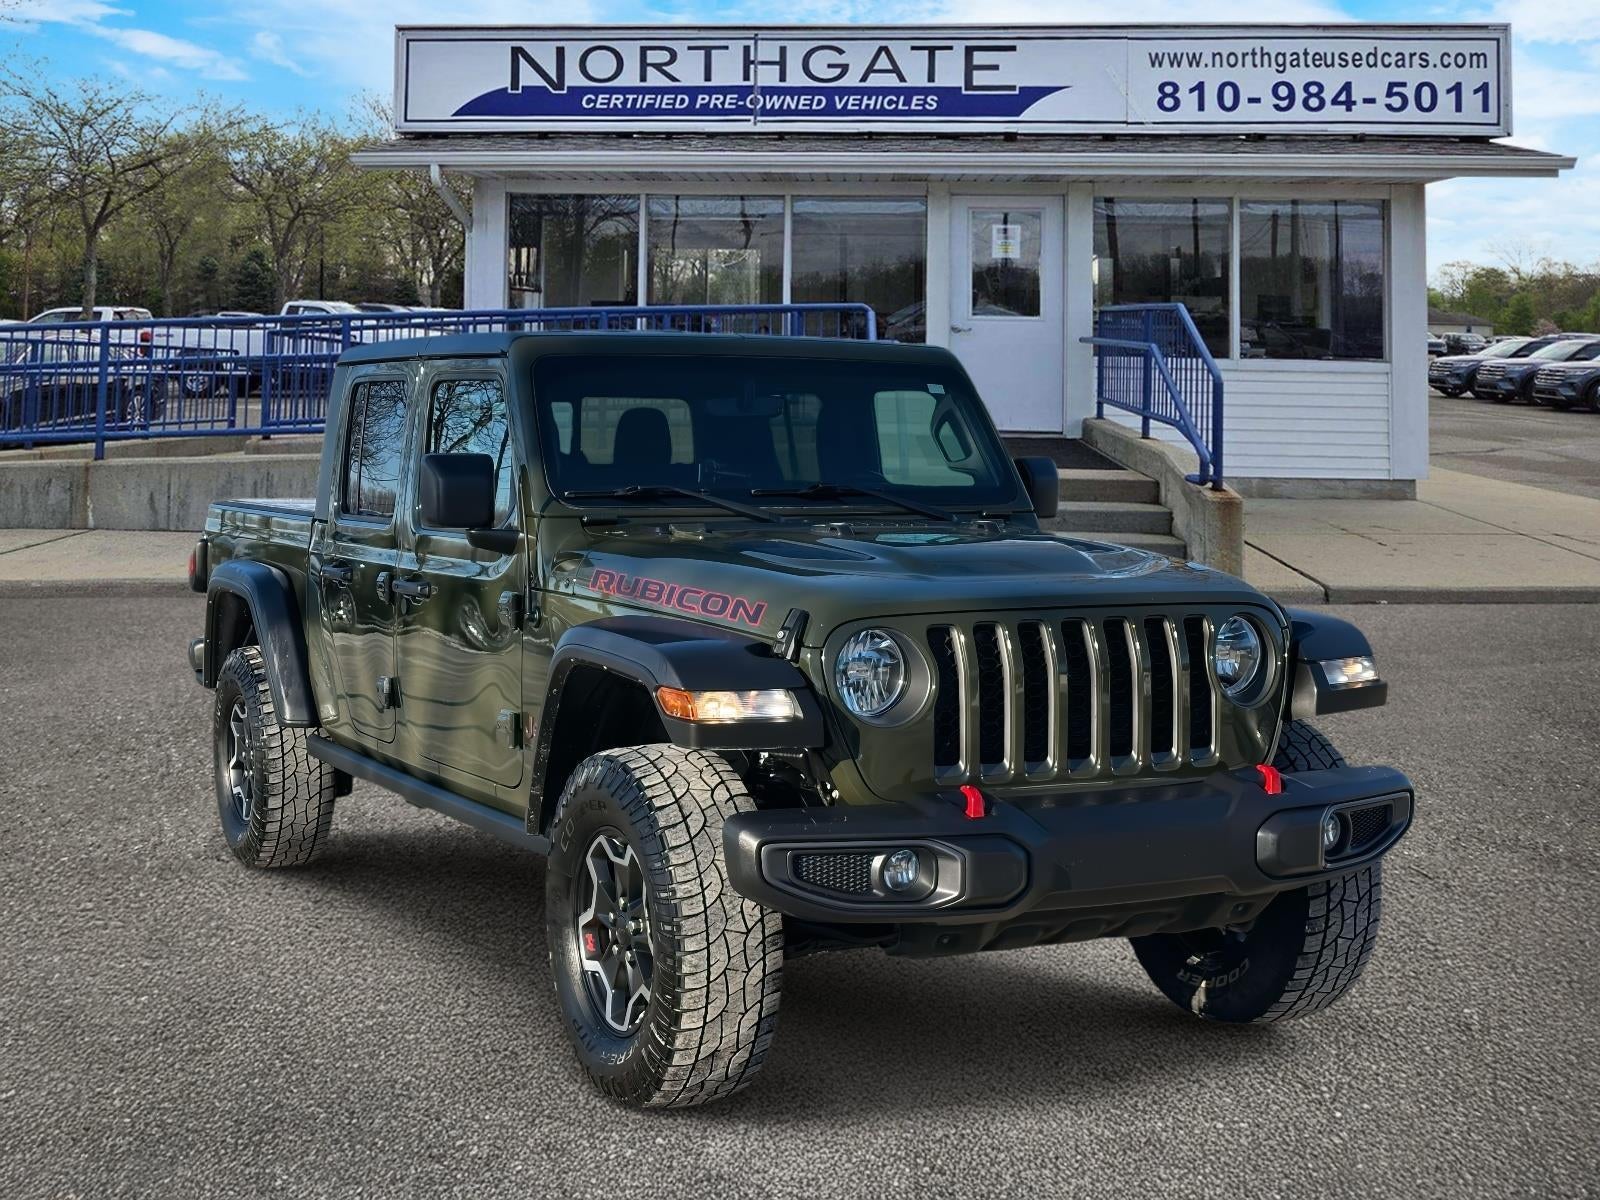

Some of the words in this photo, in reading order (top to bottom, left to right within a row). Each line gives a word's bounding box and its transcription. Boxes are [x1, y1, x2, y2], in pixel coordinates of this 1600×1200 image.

[509, 44, 1018, 93] NORTHGATE
[1148, 47, 1488, 74] www.northgateusedcars.com
[581, 93, 689, 110] CERTIFIED
[695, 94, 827, 110] PRE-OWNED
[834, 94, 939, 111] VEHICLES
[1156, 80, 1492, 114] 810-984-5011
[589, 568, 767, 626] RUBICON
